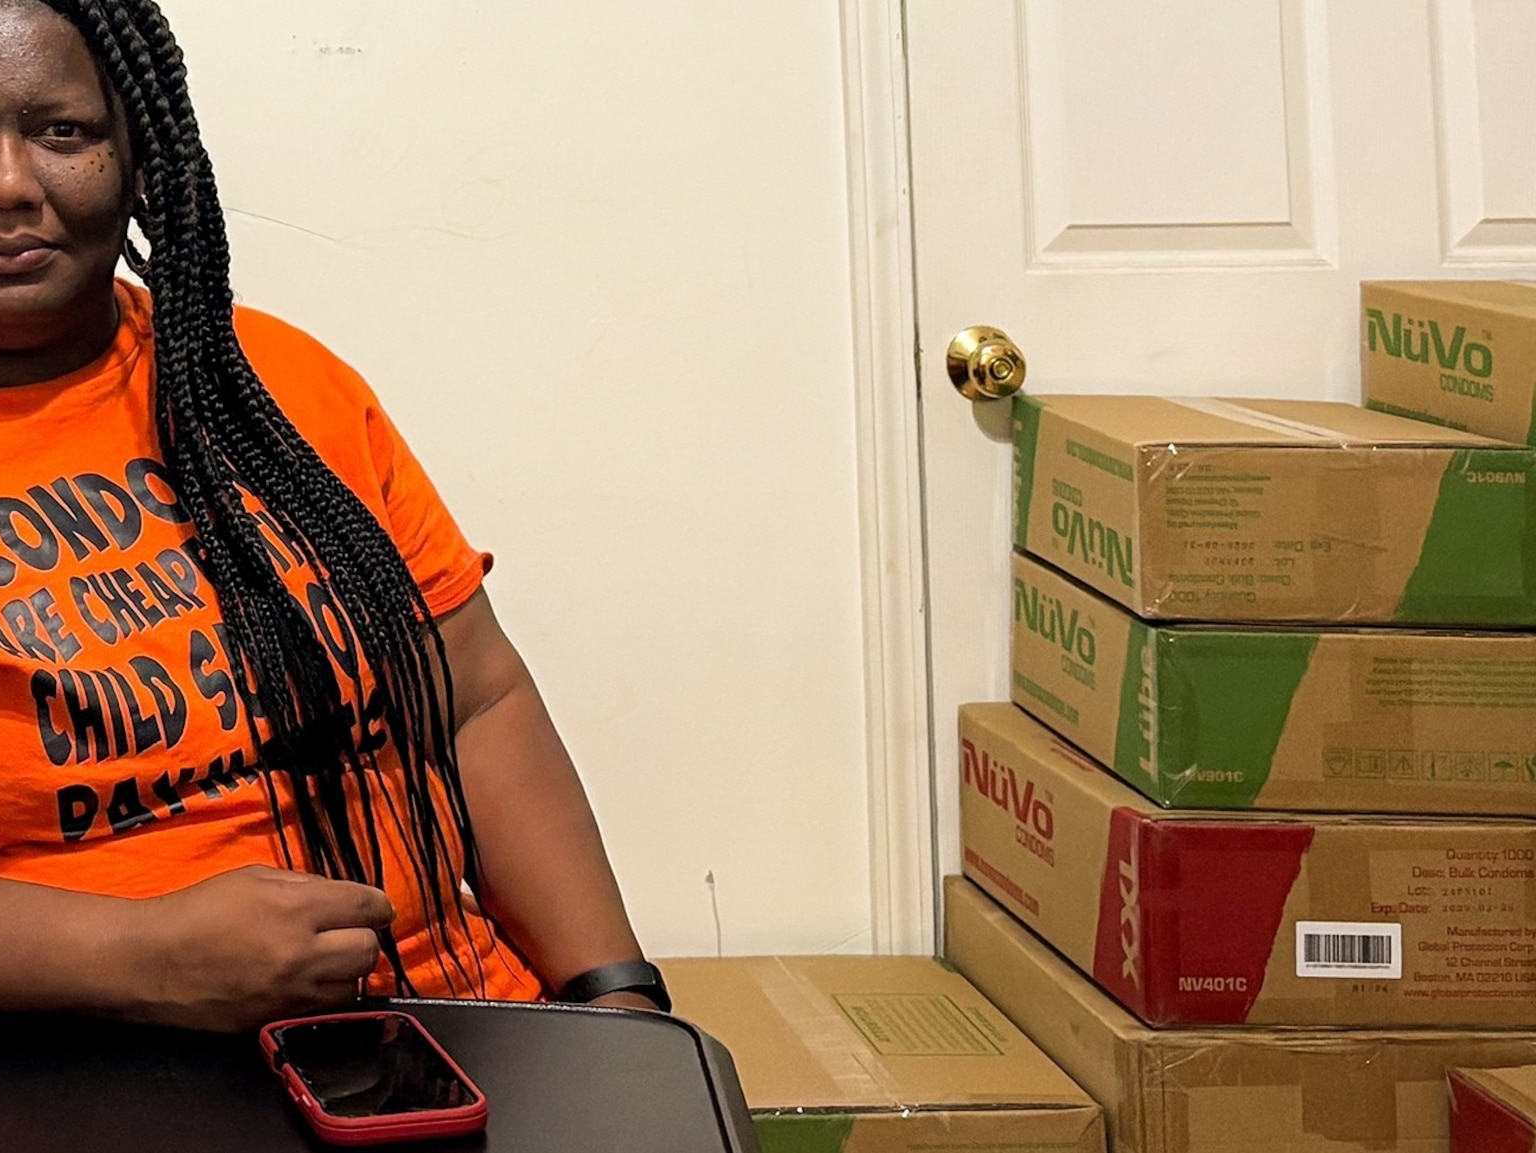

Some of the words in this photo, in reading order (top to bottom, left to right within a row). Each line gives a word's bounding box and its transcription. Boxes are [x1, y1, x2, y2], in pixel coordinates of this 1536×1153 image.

[1366, 308, 1493, 378] NüVo
[1440, 374, 1493, 403] CONDOMS
[69, 540, 210, 646] CHEAP
[30, 655, 189, 766] CHILD
[962, 738, 1054, 841] NüVo
[1446, 848, 1498, 863] Quantity
[1412, 866, 1446, 879] Desc:
[1449, 866, 1475, 879] Bulk
[1478, 866, 1535, 879] Condoms
[1371, 902, 1397, 915] Exp.
[1399, 902, 1432, 915] Date:
[1447, 926, 1522, 937] Manufactured
[1417, 941, 1449, 952] Global
[1452, 941, 1507, 952] Protection
[1445, 957, 1458, 967] 12
[1460, 957, 1502, 968] Channel
[1178, 977, 1248, 992] NV401C
[1455, 972, 1474, 983] MA
